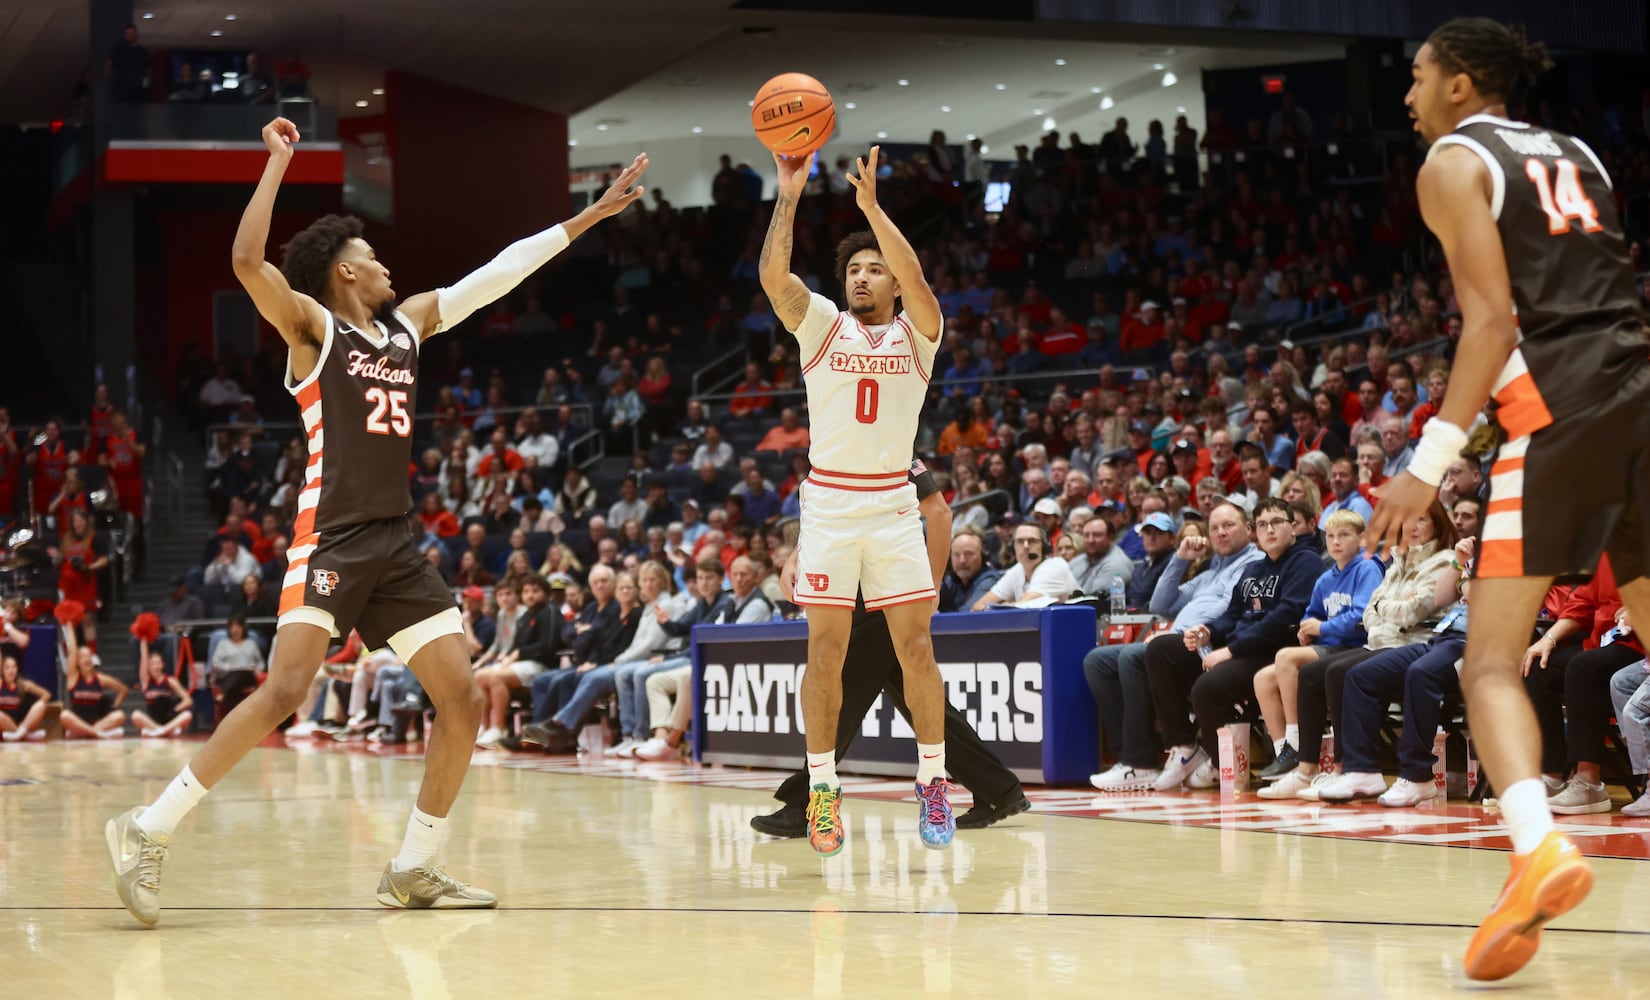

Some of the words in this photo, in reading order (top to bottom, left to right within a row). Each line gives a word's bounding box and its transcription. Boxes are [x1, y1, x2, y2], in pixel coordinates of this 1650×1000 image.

[1525, 158, 1604, 235] 14
[829, 352, 911, 375] DAYTON
[365, 387, 412, 438] 25
[855, 378, 879, 424] 0
